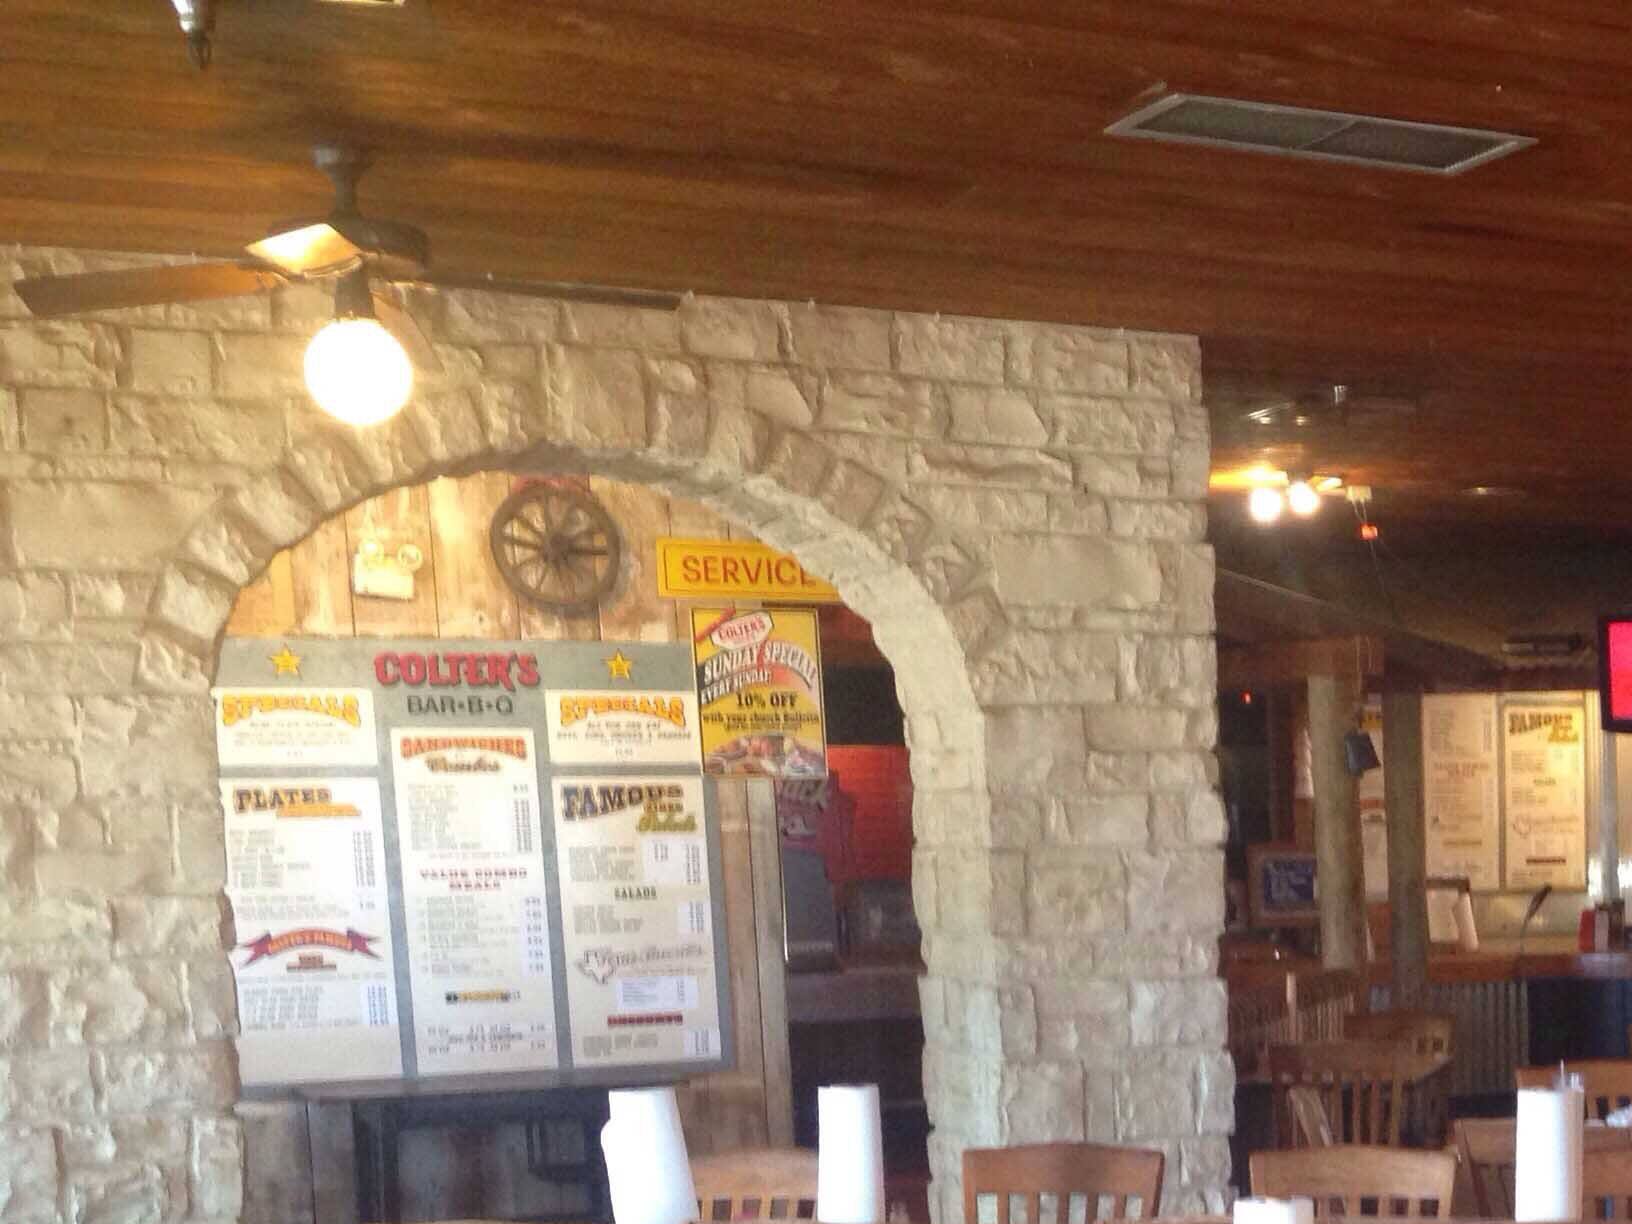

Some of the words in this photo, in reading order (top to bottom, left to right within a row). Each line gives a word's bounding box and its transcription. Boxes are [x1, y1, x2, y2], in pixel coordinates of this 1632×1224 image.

[374, 650, 542, 692] COLTER'S
[703, 641, 759, 684] SUNDAY
[763, 640, 818, 685] SPECIAL
[736, 690, 766, 707] 10%
[769, 690, 799, 707] OFF
[702, 711, 724, 723] with
[233, 785, 332, 814] PLATES
[562, 784, 685, 822] FAMOUS
[613, 886, 658, 901] SALADS
